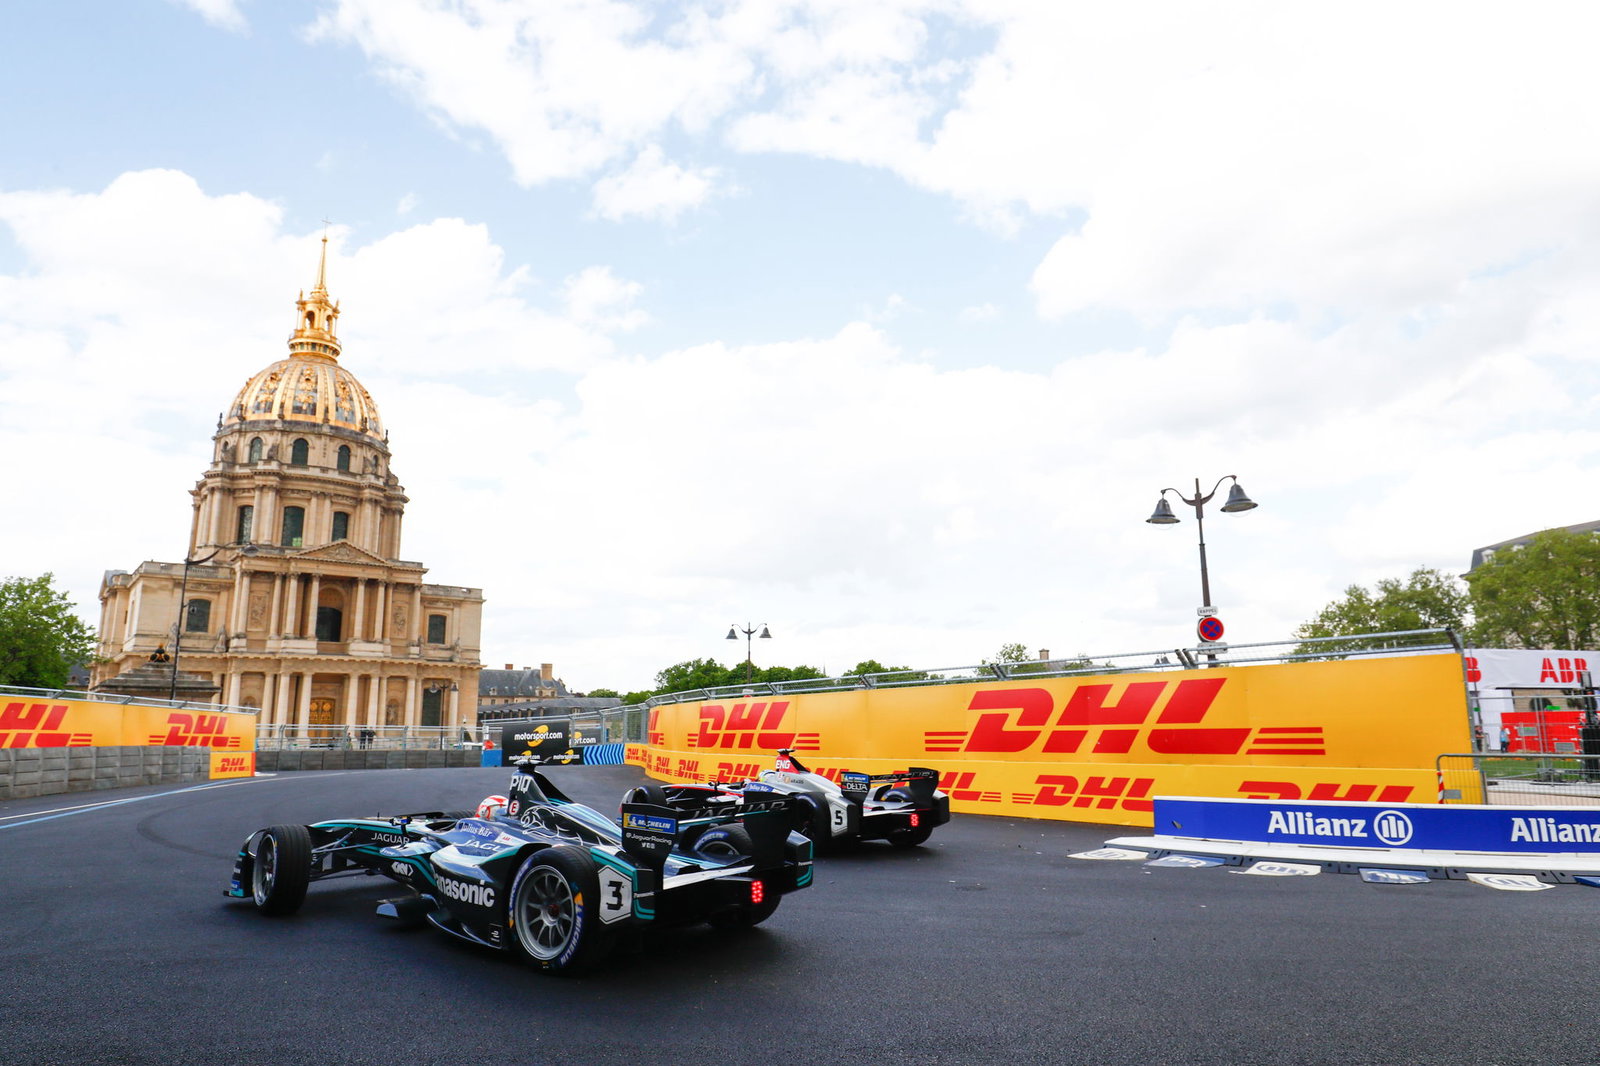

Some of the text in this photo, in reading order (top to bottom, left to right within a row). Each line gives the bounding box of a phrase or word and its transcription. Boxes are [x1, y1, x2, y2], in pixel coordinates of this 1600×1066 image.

[0, 703, 72, 748] HL
[697, 701, 796, 750] DHL
[964, 677, 1252, 755] DHL
[165, 713, 229, 747] DHL
[514, 731, 563, 741] motorsport.com
[220, 758, 245, 772] DHL
[678, 759, 700, 780] DHL
[775, 760, 791, 769] ENG
[1033, 775, 1154, 812] DHL
[637, 819, 671, 829] MCHELIN
[834, 810, 844, 826] 5
[1268, 810, 1368, 838] Allianz
[371, 832, 410, 846] JAGUAR
[606, 880, 625, 911] 3
